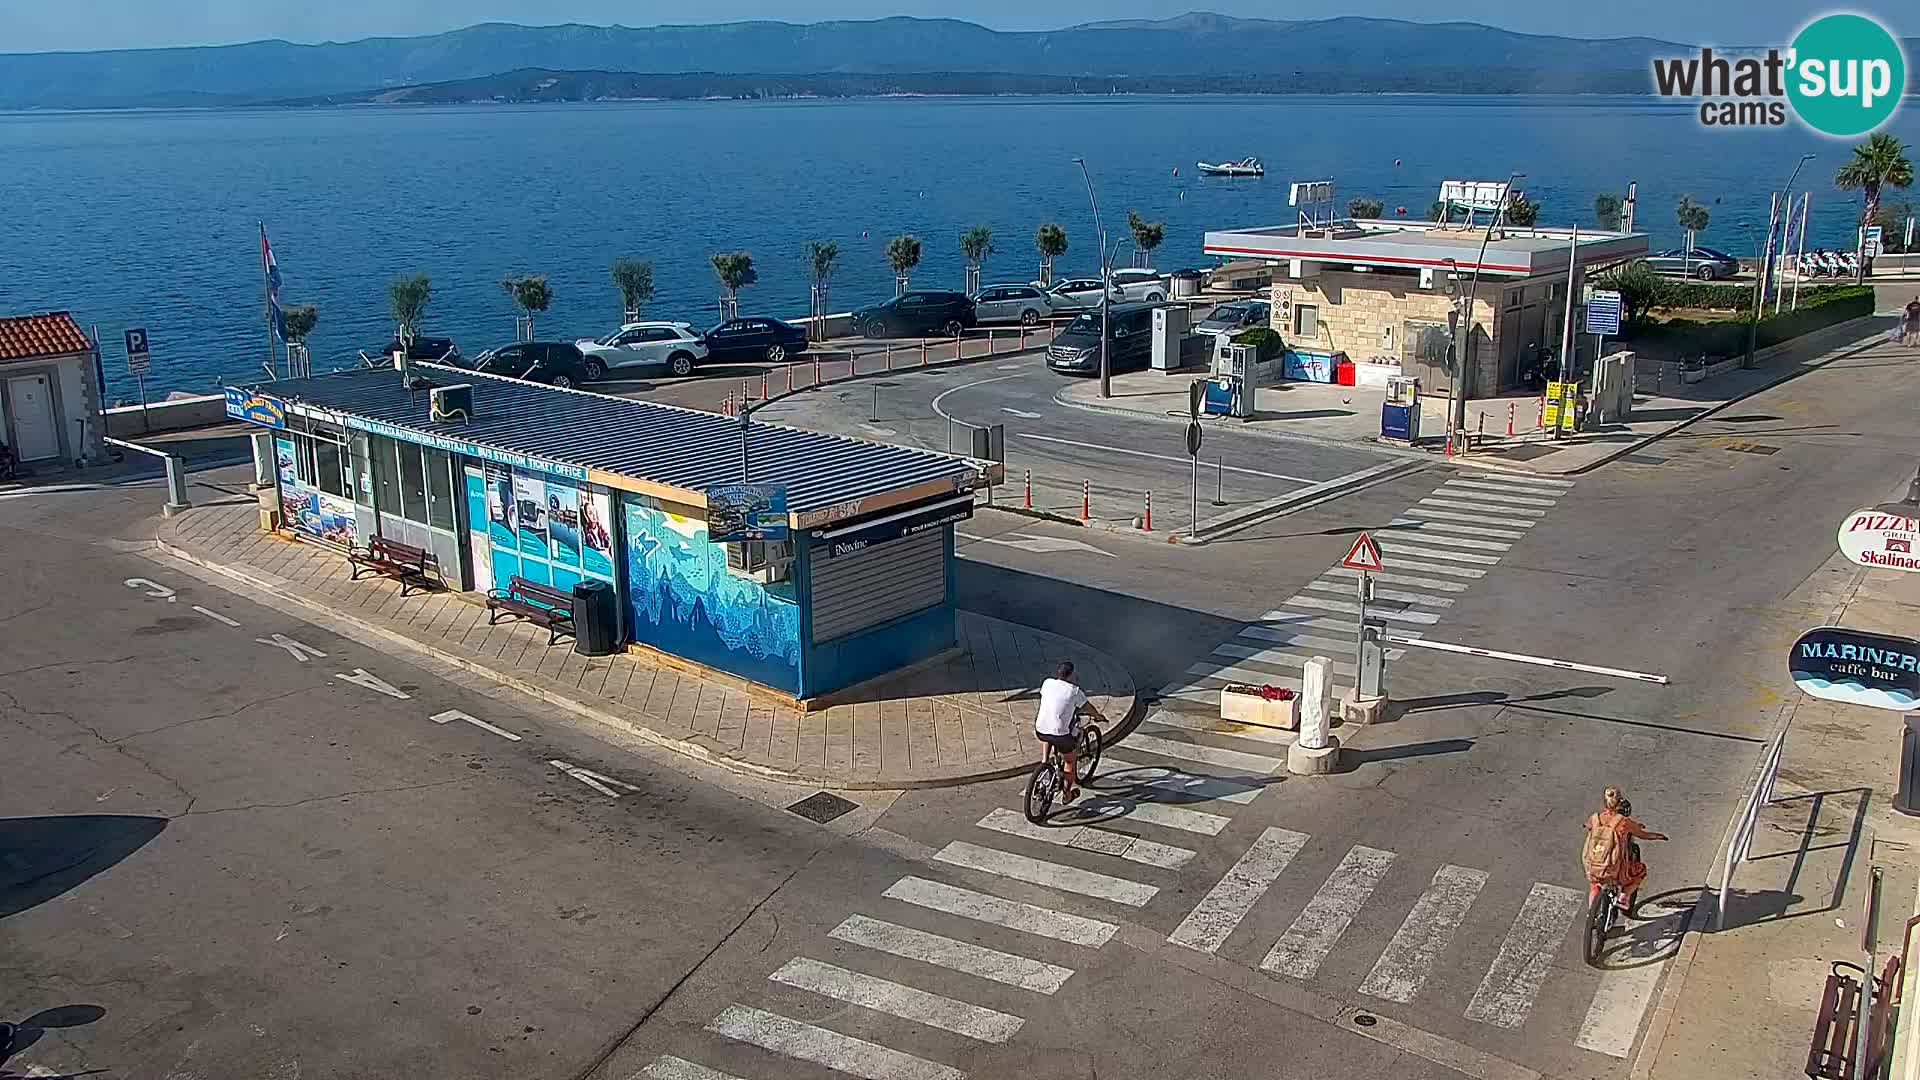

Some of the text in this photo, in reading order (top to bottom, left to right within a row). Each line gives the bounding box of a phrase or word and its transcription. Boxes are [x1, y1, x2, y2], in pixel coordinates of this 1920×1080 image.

[130, 333, 142, 350] P
[436, 437, 468, 453] POSTAJA
[478, 446, 492, 460] BUS
[494, 450, 526, 466] STATION
[528, 457, 554, 472] TICKET
[556, 461, 582, 478] OFFICE
[1849, 516, 1920, 532] PIZZE
[1882, 531, 1917, 541] GRILL
[1801, 642, 1920, 674] MARINER
[1830, 662, 1899, 681] caffe bar
